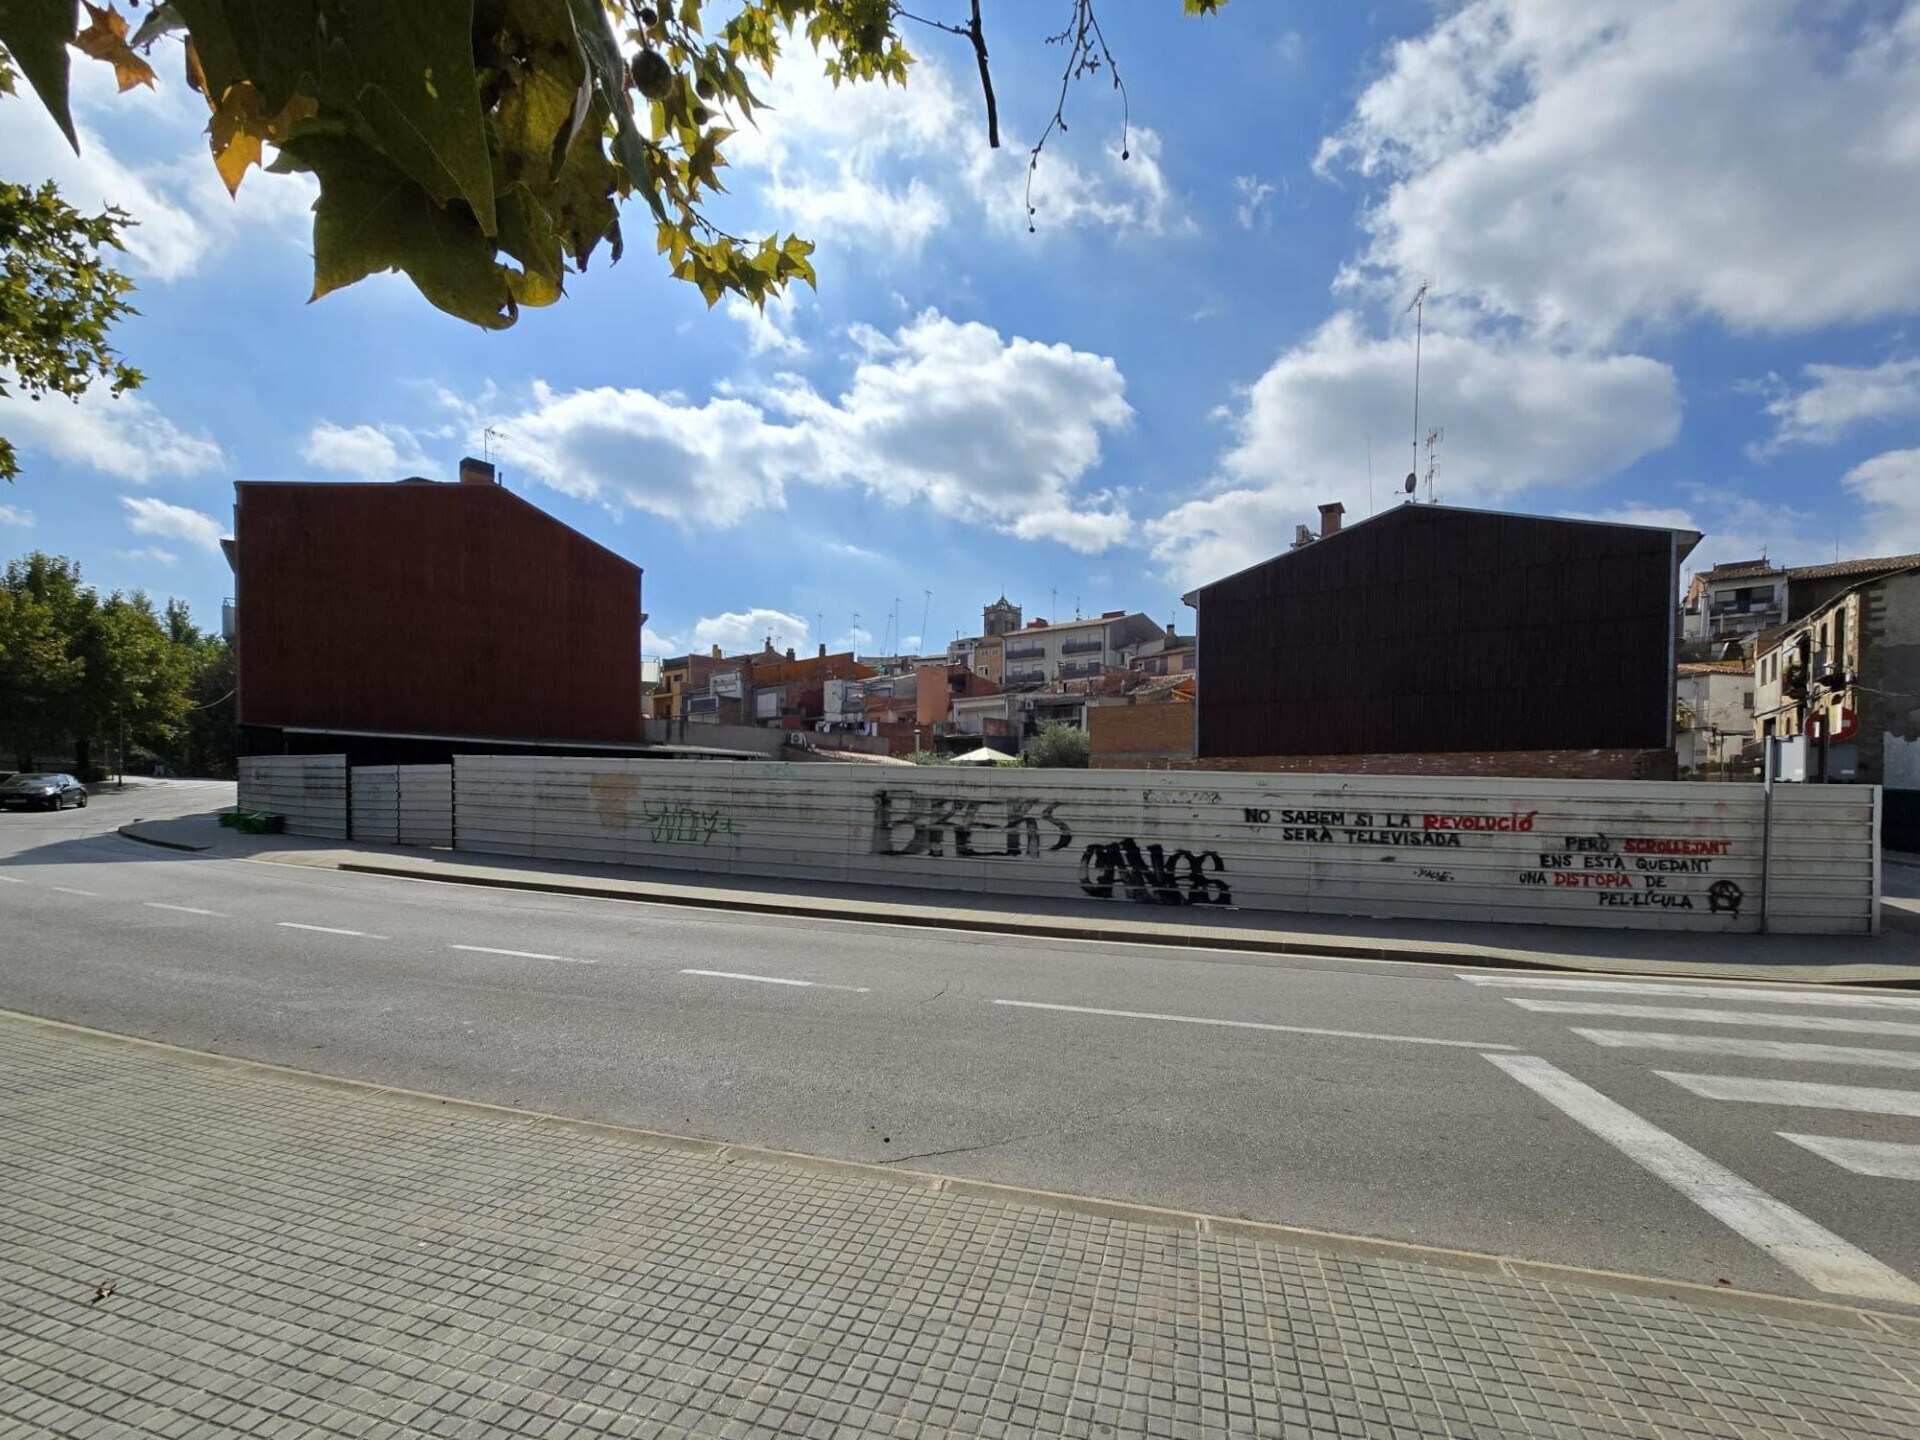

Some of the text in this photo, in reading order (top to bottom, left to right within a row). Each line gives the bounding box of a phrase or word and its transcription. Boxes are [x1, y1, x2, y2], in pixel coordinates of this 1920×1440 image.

[1244, 808, 1271, 824] NO
[1281, 810, 1345, 826] SABEM
[1354, 813, 1374, 828] SI
[1386, 814, 1412, 829] LA
[1343, 830, 1461, 847] TELEVISADA
[1623, 838, 1733, 855] SCROLLEJANT
[1540, 853, 1573, 868] ENS
[1636, 857, 1713, 872] QUEDANT
[1519, 871, 1548, 885] UNA
[1645, 875, 1668, 888] DE
